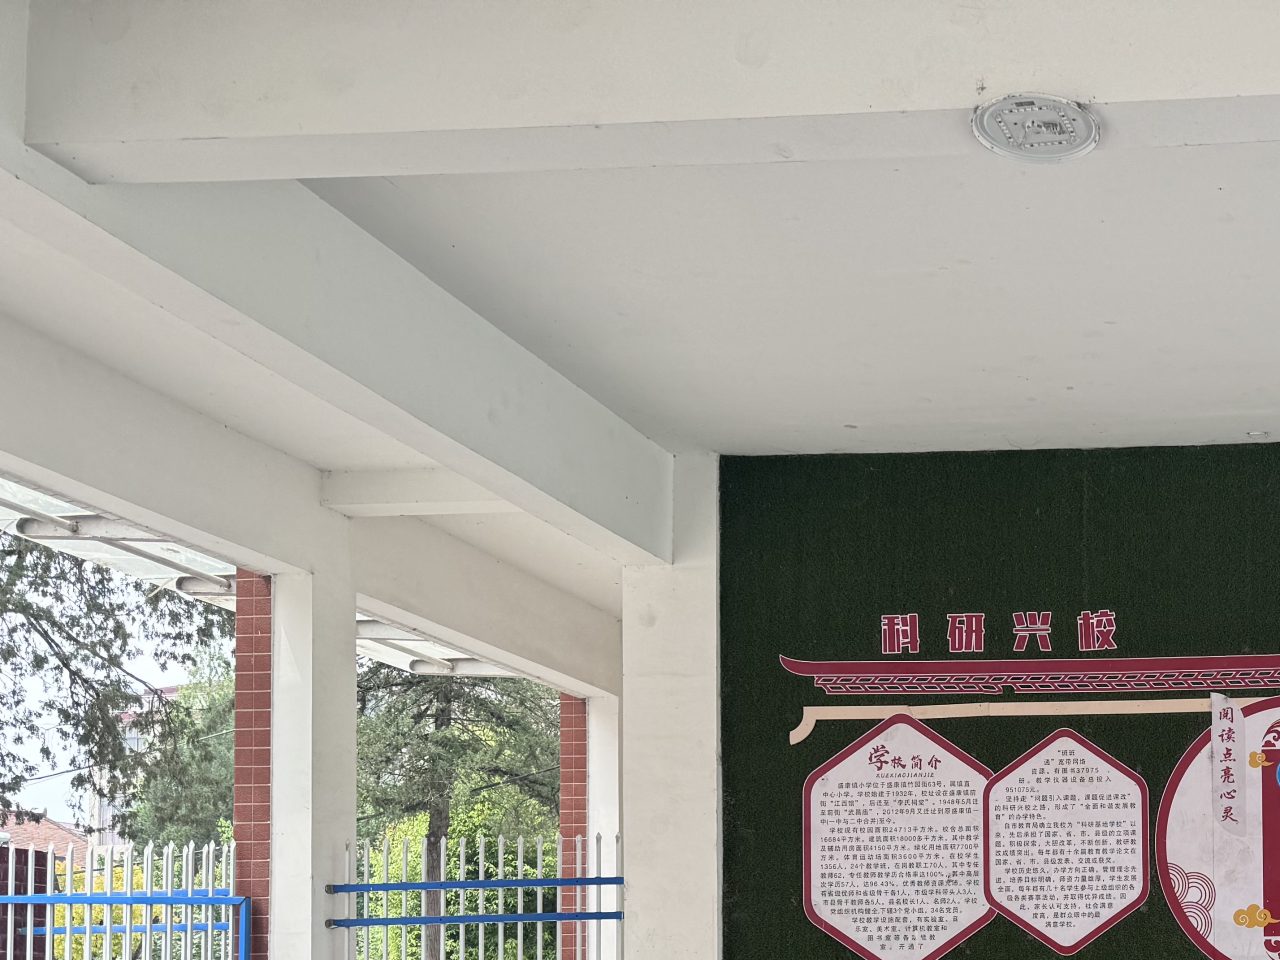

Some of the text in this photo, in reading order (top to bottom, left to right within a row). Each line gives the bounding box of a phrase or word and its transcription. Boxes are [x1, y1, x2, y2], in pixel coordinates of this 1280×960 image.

[881, 610, 1118, 654] 科研兴校
[868, 744, 942, 771] 学校简介
[1218, 706, 1239, 825] 阅读点亮心灵
